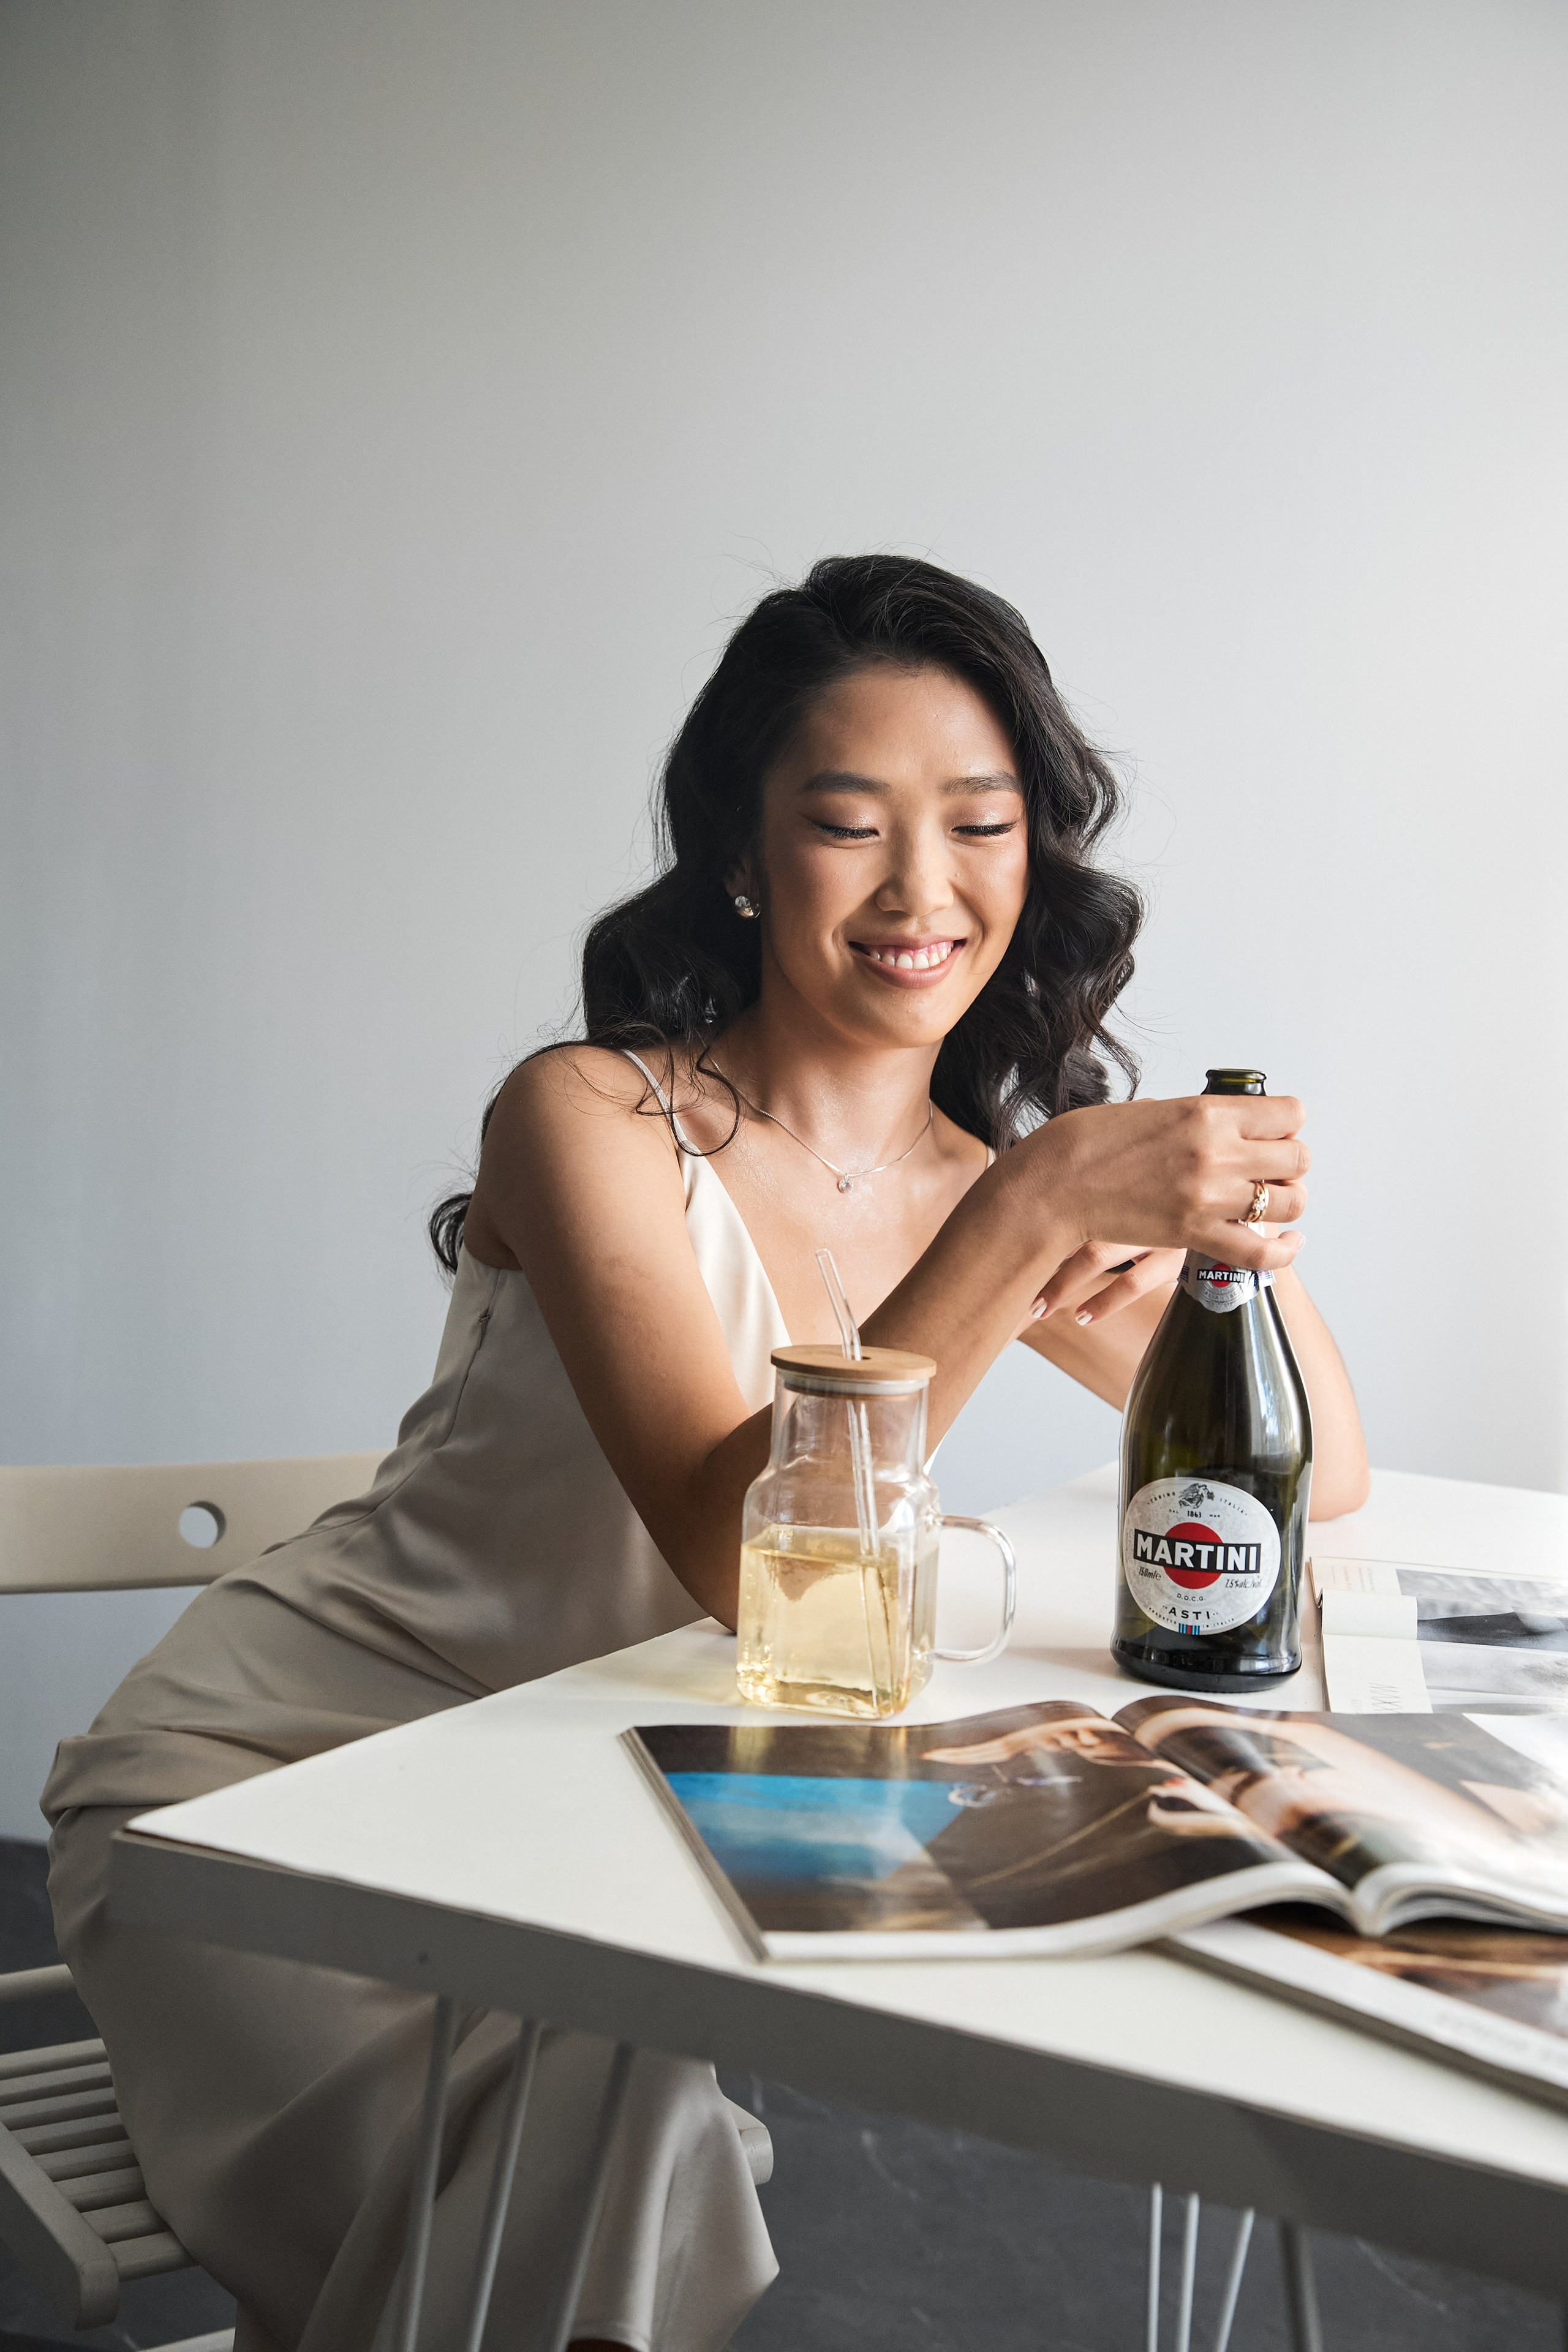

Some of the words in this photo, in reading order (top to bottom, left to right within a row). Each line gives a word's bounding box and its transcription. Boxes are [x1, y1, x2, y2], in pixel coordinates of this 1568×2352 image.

[1199, 1270, 1244, 1282] MARTINI
[1219, 1498, 1244, 1513] ITALIA
[1136, 1533, 1257, 1571] MARTINI
[1177, 1593, 1206, 1602] D.O.C.G.
[1169, 1607, 1210, 1620] ASTI
